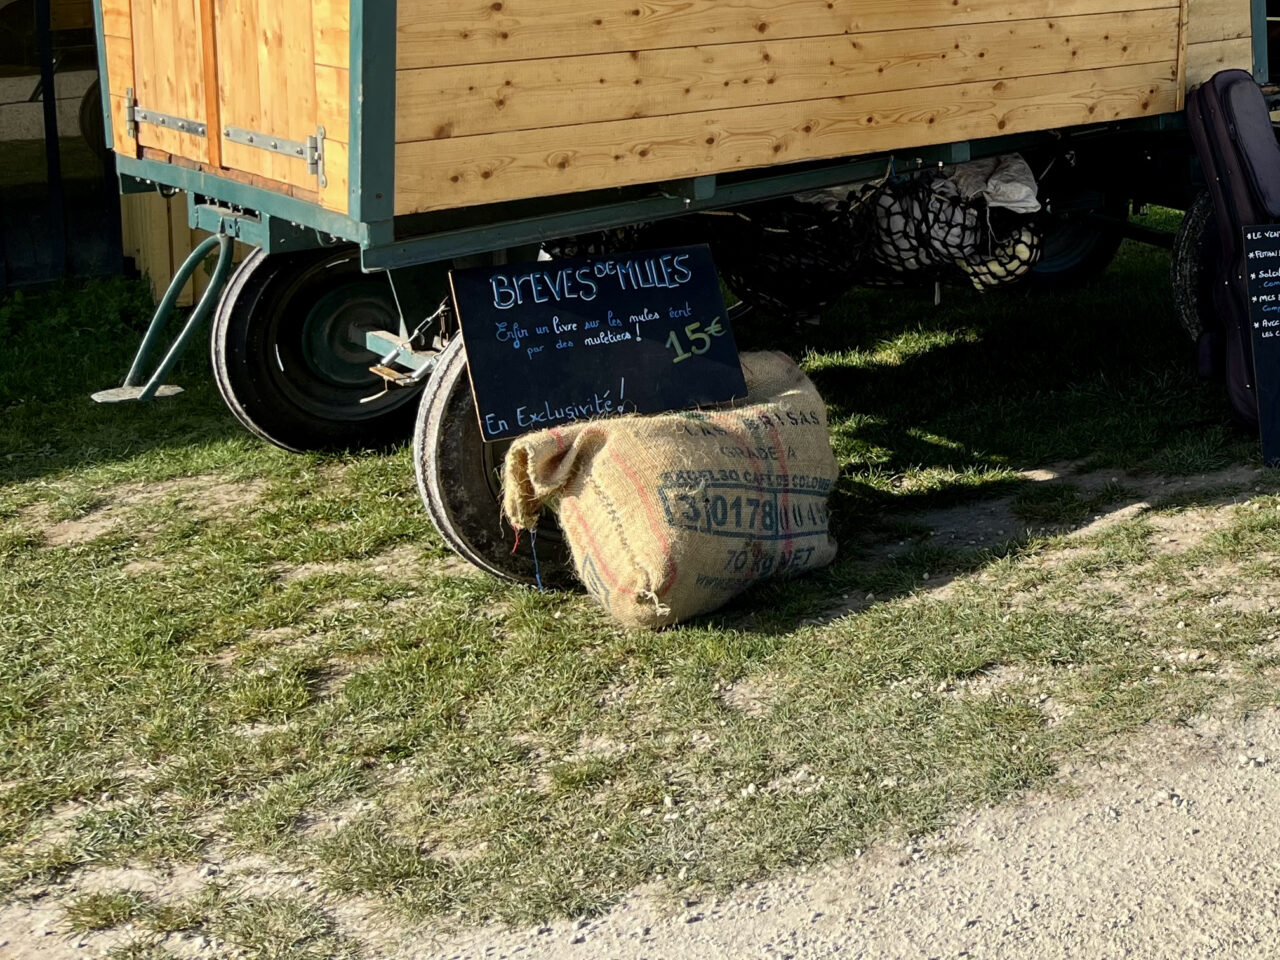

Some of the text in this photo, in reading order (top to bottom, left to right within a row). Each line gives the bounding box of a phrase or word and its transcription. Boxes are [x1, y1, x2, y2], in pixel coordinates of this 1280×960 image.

[1252, 231, 1263, 239] LE
[594, 260, 617, 278] DE
[616, 253, 692, 291] MULES
[496, 301, 692, 349] Enfin un livre sur les mules écrit
[526, 343, 545, 361] par
[555, 337, 574, 350] des
[665, 316, 726, 363] 15€
[485, 413, 508, 436] En
[719, 444, 797, 461] GRADE A
[780, 547, 816, 568] NET
